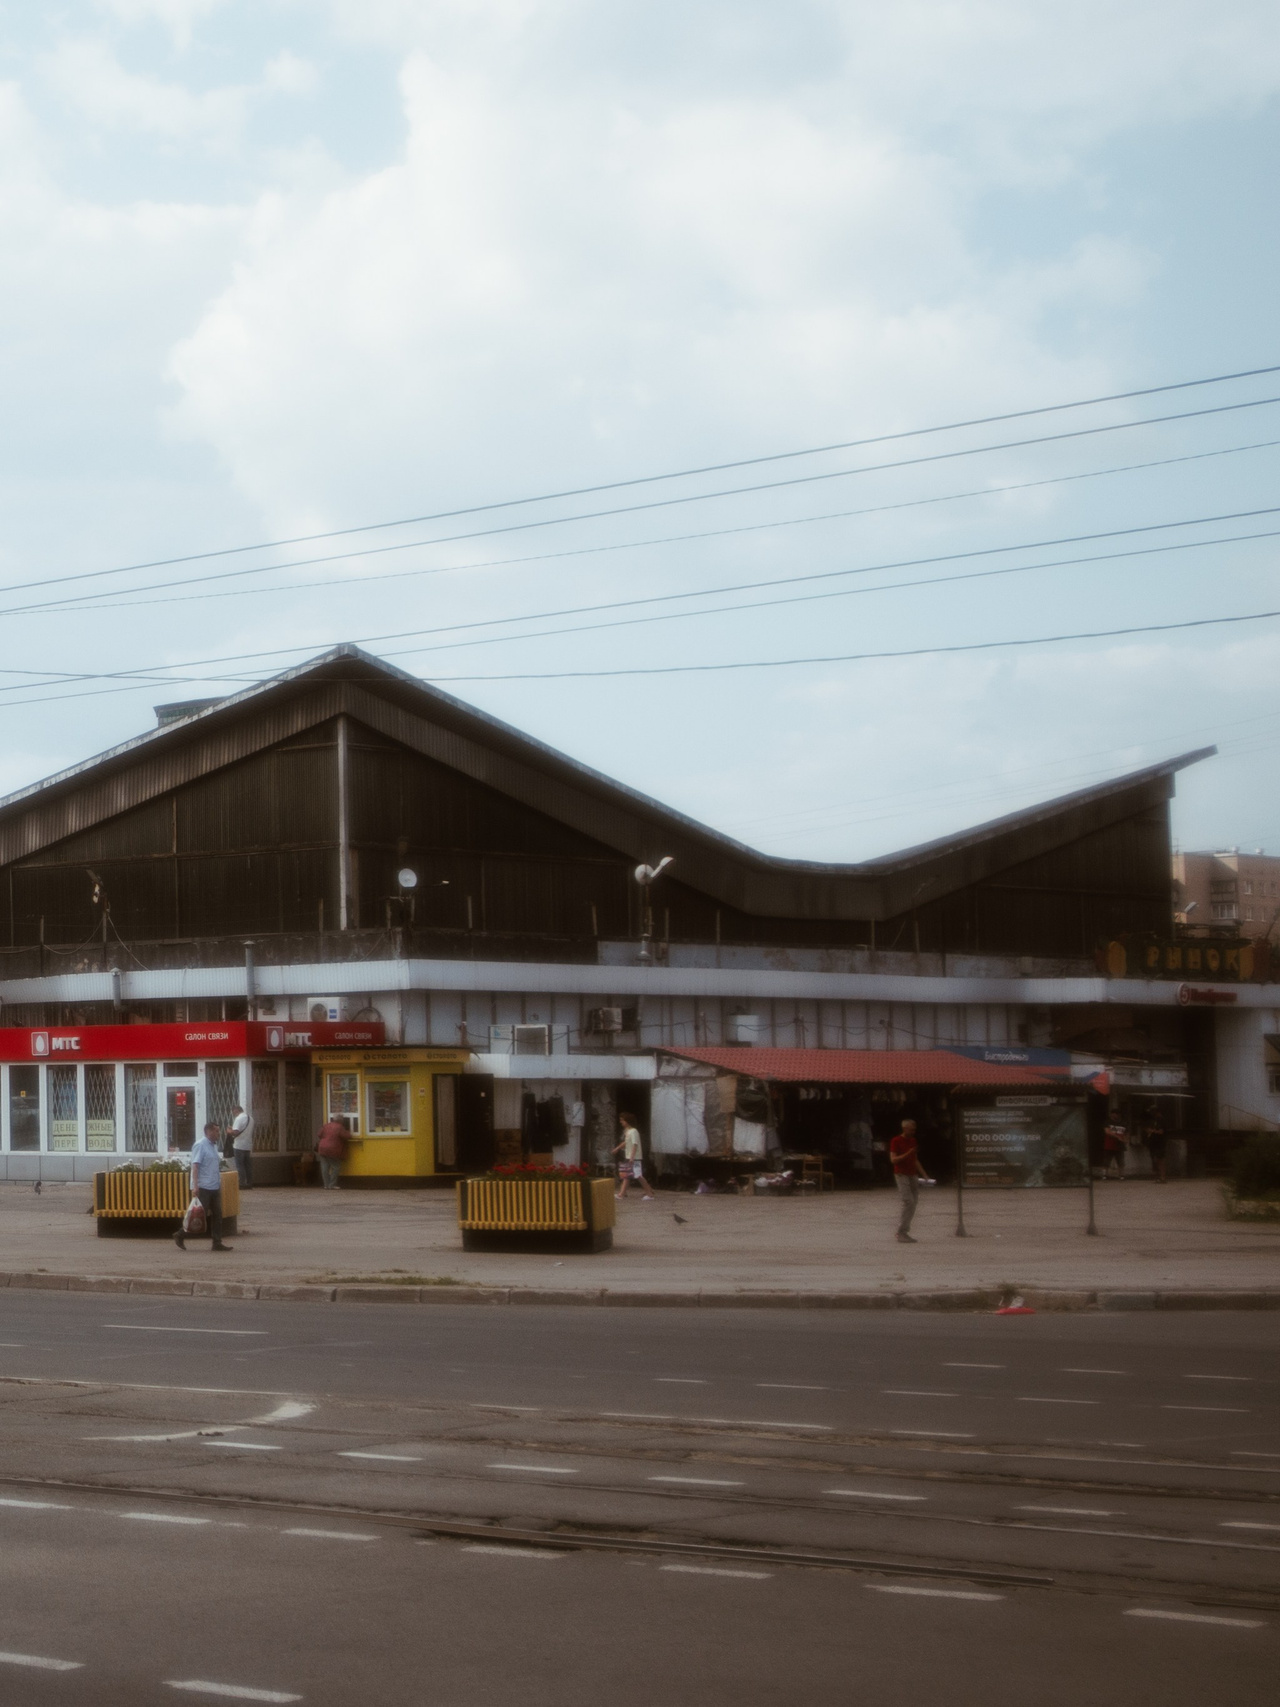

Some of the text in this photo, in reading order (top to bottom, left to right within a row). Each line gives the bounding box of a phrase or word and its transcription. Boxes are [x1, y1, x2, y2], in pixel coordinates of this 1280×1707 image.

[185, 1032, 229, 1041] салон связи
[284, 1031, 312, 1046] МТС
[334, 1032, 354, 1040] салон
[51, 1036, 81, 1051] МТС
[53, 1121, 77, 1133] ДЕНЕ
[87, 1121, 113, 1133] ЖНЫЕ
[54, 1137, 77, 1149] ПЕРЕ
